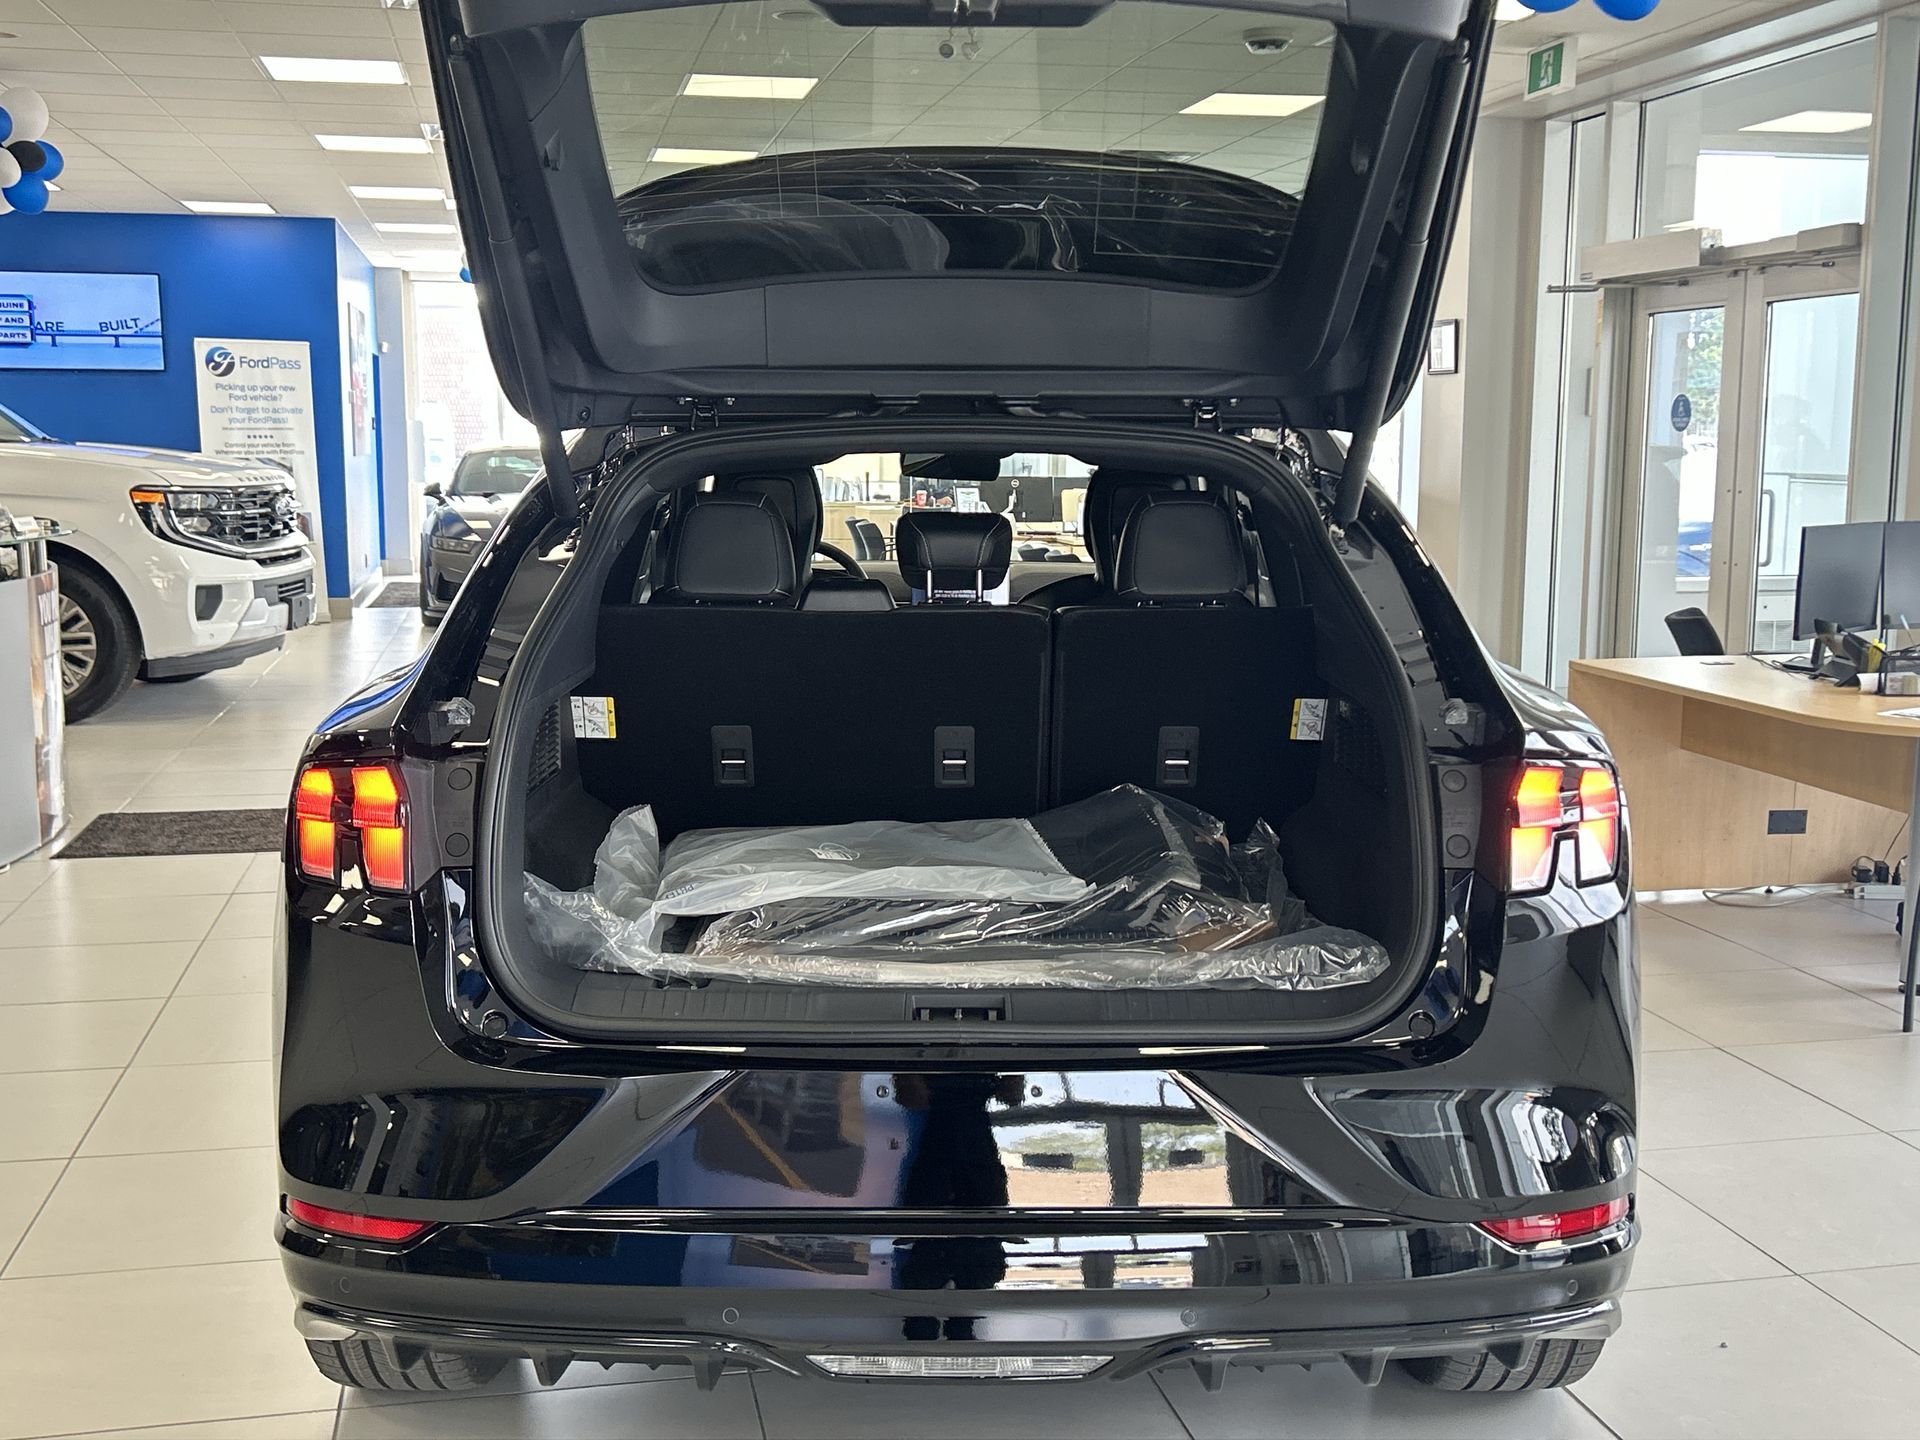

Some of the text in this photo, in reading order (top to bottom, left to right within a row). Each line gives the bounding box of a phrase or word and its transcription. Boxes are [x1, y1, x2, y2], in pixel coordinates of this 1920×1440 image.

[35, 317, 140, 333] ARE BUILT
[240, 356, 301, 369] FordPass
[215, 383, 245, 392] Picking
[229, 393, 283, 401] Ford vehicle?
[210, 405, 233, 414] Don't
[235, 406, 260, 415] forget
[228, 417, 246, 425] your
